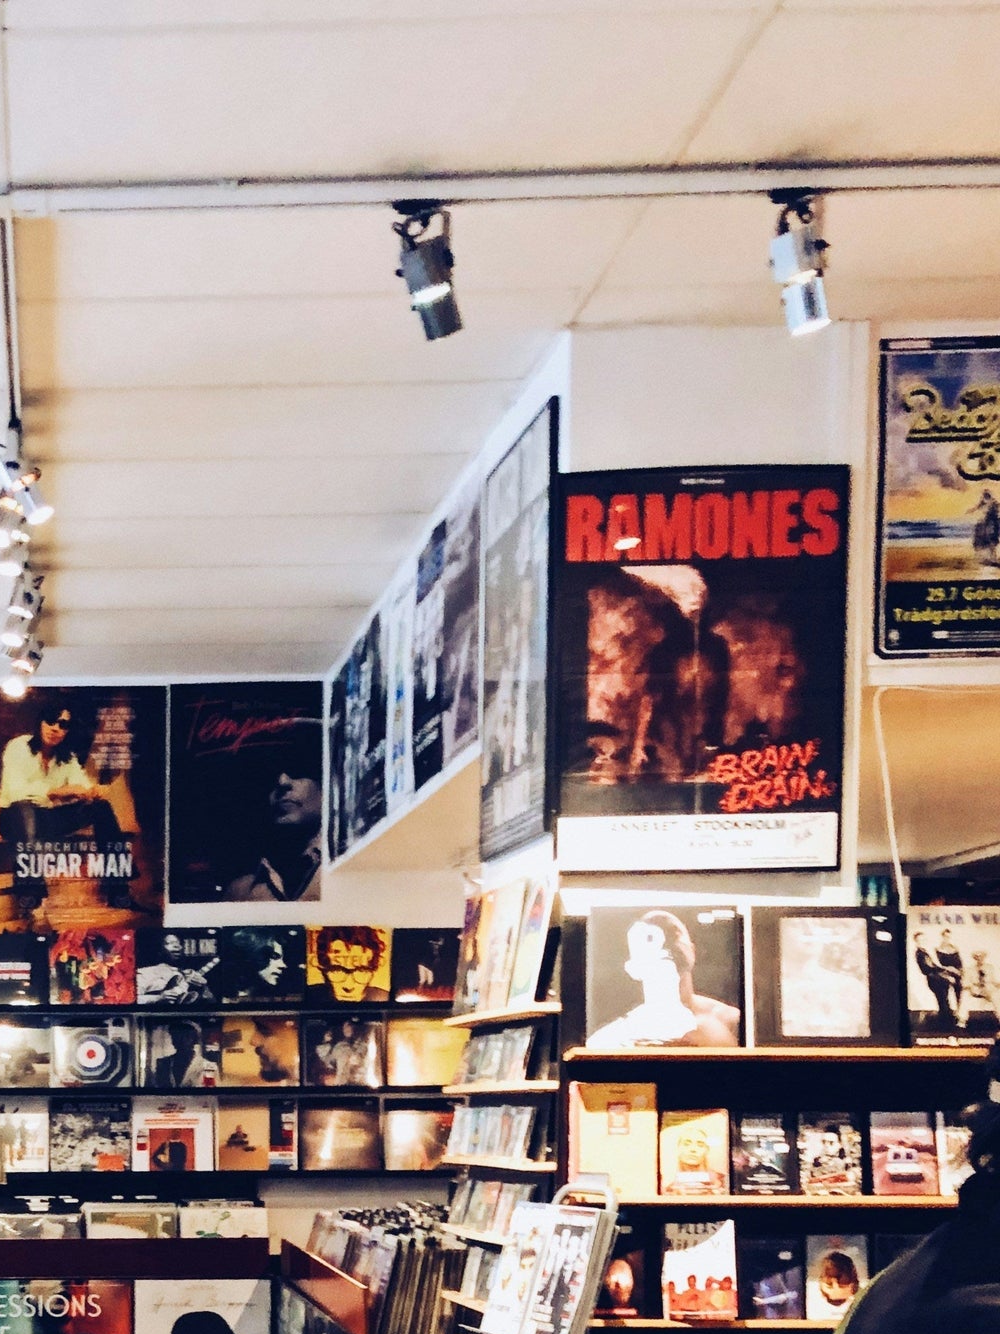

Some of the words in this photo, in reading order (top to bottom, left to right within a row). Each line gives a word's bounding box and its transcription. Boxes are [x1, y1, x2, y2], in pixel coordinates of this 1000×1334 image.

[565, 489, 840, 562] RAMONES
[709, 739, 821, 784] BRAIN
[720, 769, 835, 815] DRAIN
[694, 819, 787, 831] STOCKHOLM
[17, 841, 98, 852] SEARCHING
[107, 841, 133, 852] FOR
[16, 853, 82, 879] SUGAR
[86, 852, 133, 878] MAN
